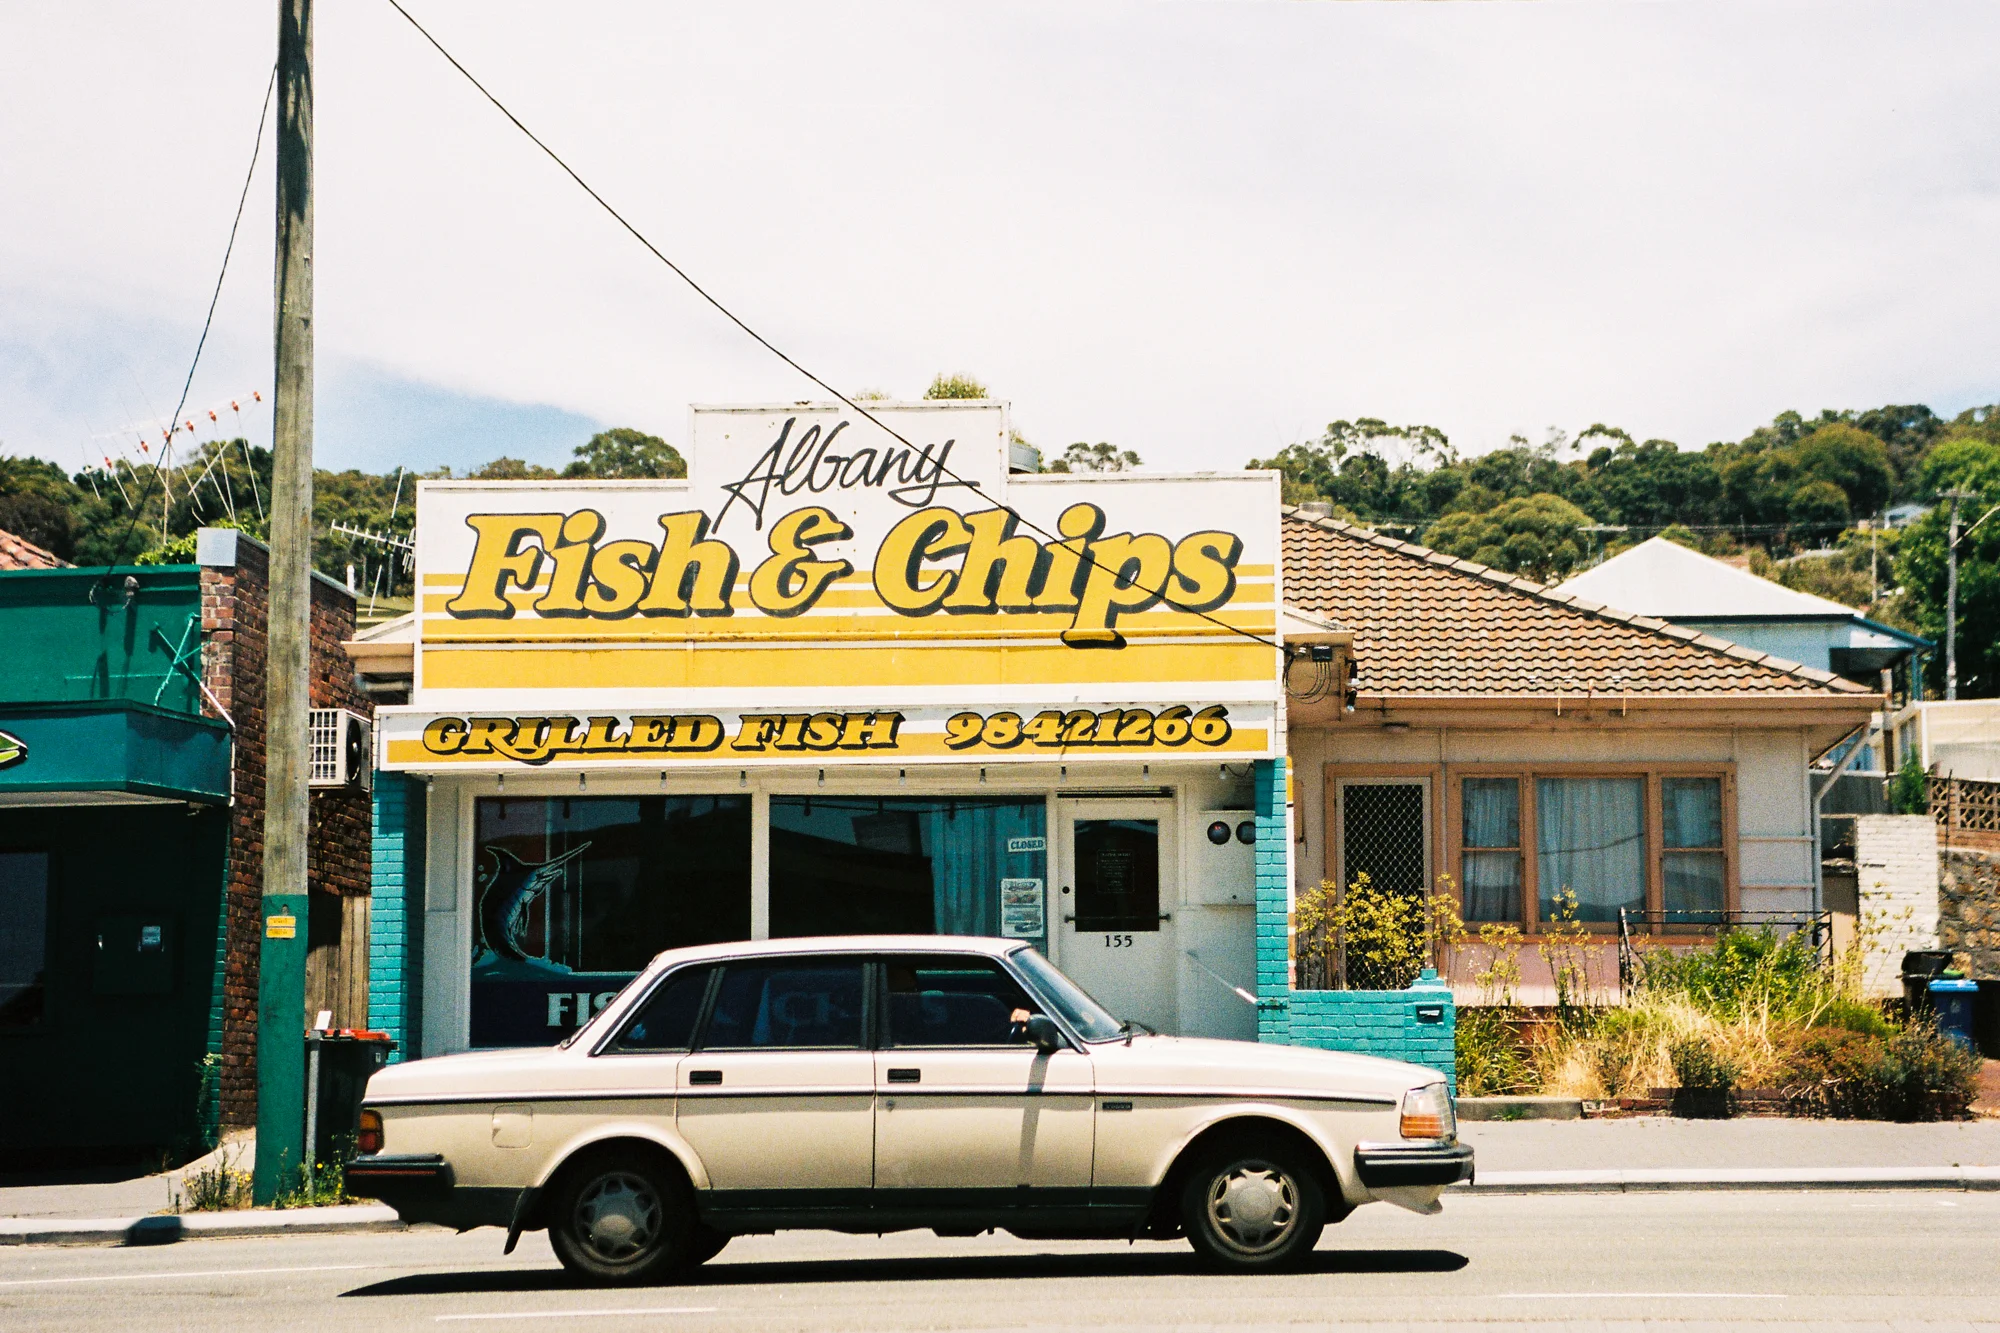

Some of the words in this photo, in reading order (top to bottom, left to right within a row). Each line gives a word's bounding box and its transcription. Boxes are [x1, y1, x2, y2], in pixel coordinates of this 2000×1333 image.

[711, 416, 981, 534] Albany
[445, 508, 739, 620] Fish
[748, 506, 854, 618] &
[872, 502, 1244, 651] Chips
[422, 714, 725, 766] GRILLED
[731, 711, 905, 752] FISH
[945, 704, 1233, 750] 98421266
[1010, 839, 1044, 850] CLOSED
[1104, 934, 1134, 949] 155
